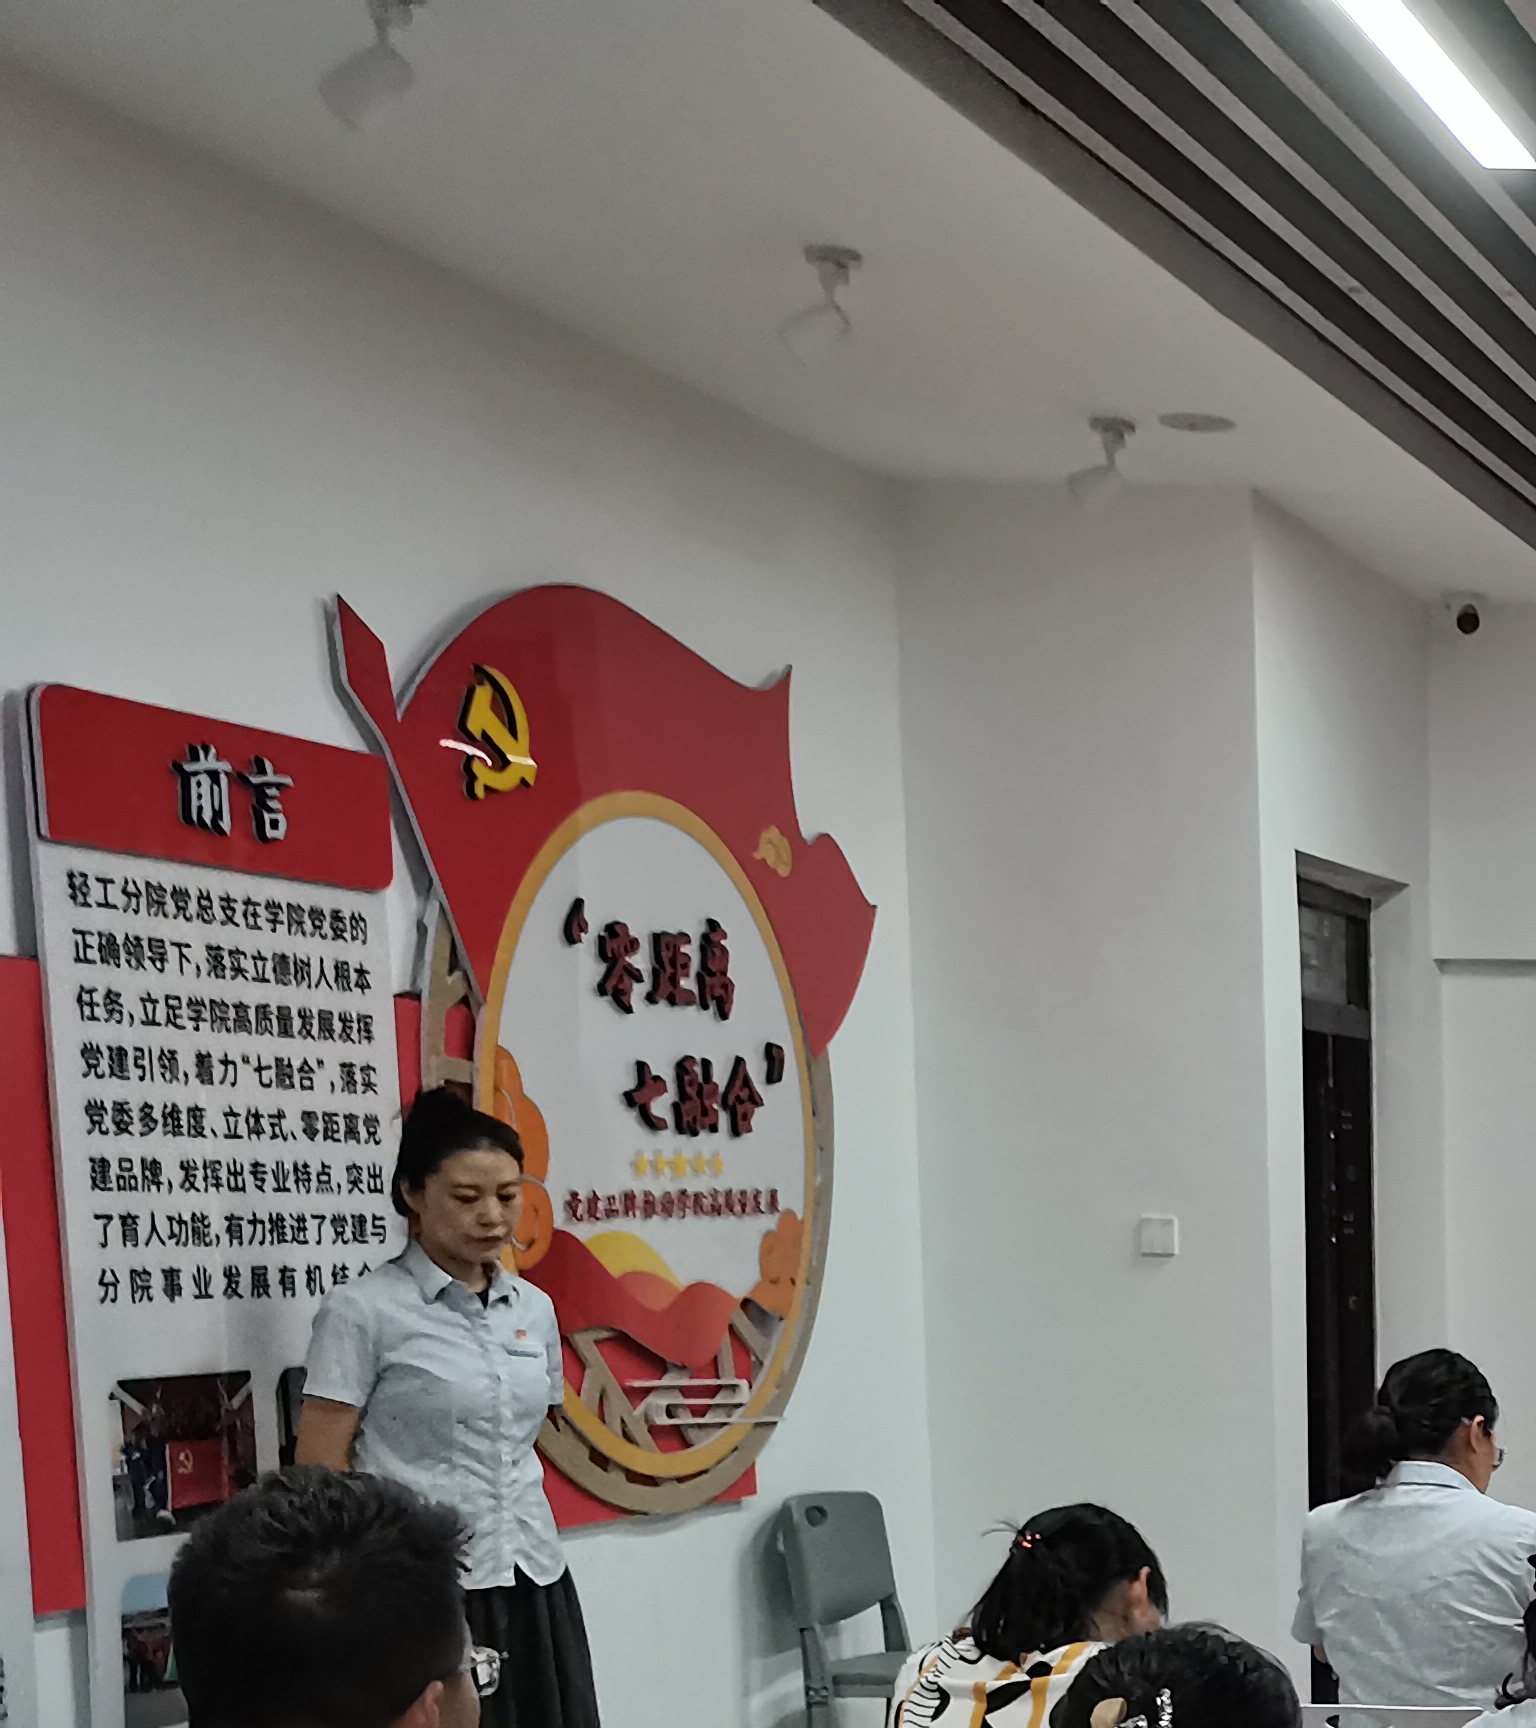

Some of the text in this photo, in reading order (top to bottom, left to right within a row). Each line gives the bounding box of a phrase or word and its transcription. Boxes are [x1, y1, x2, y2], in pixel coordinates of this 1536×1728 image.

[170, 741, 294, 843] 前言
[66, 868, 369, 946] 轻工分院党总支在学院党委的
